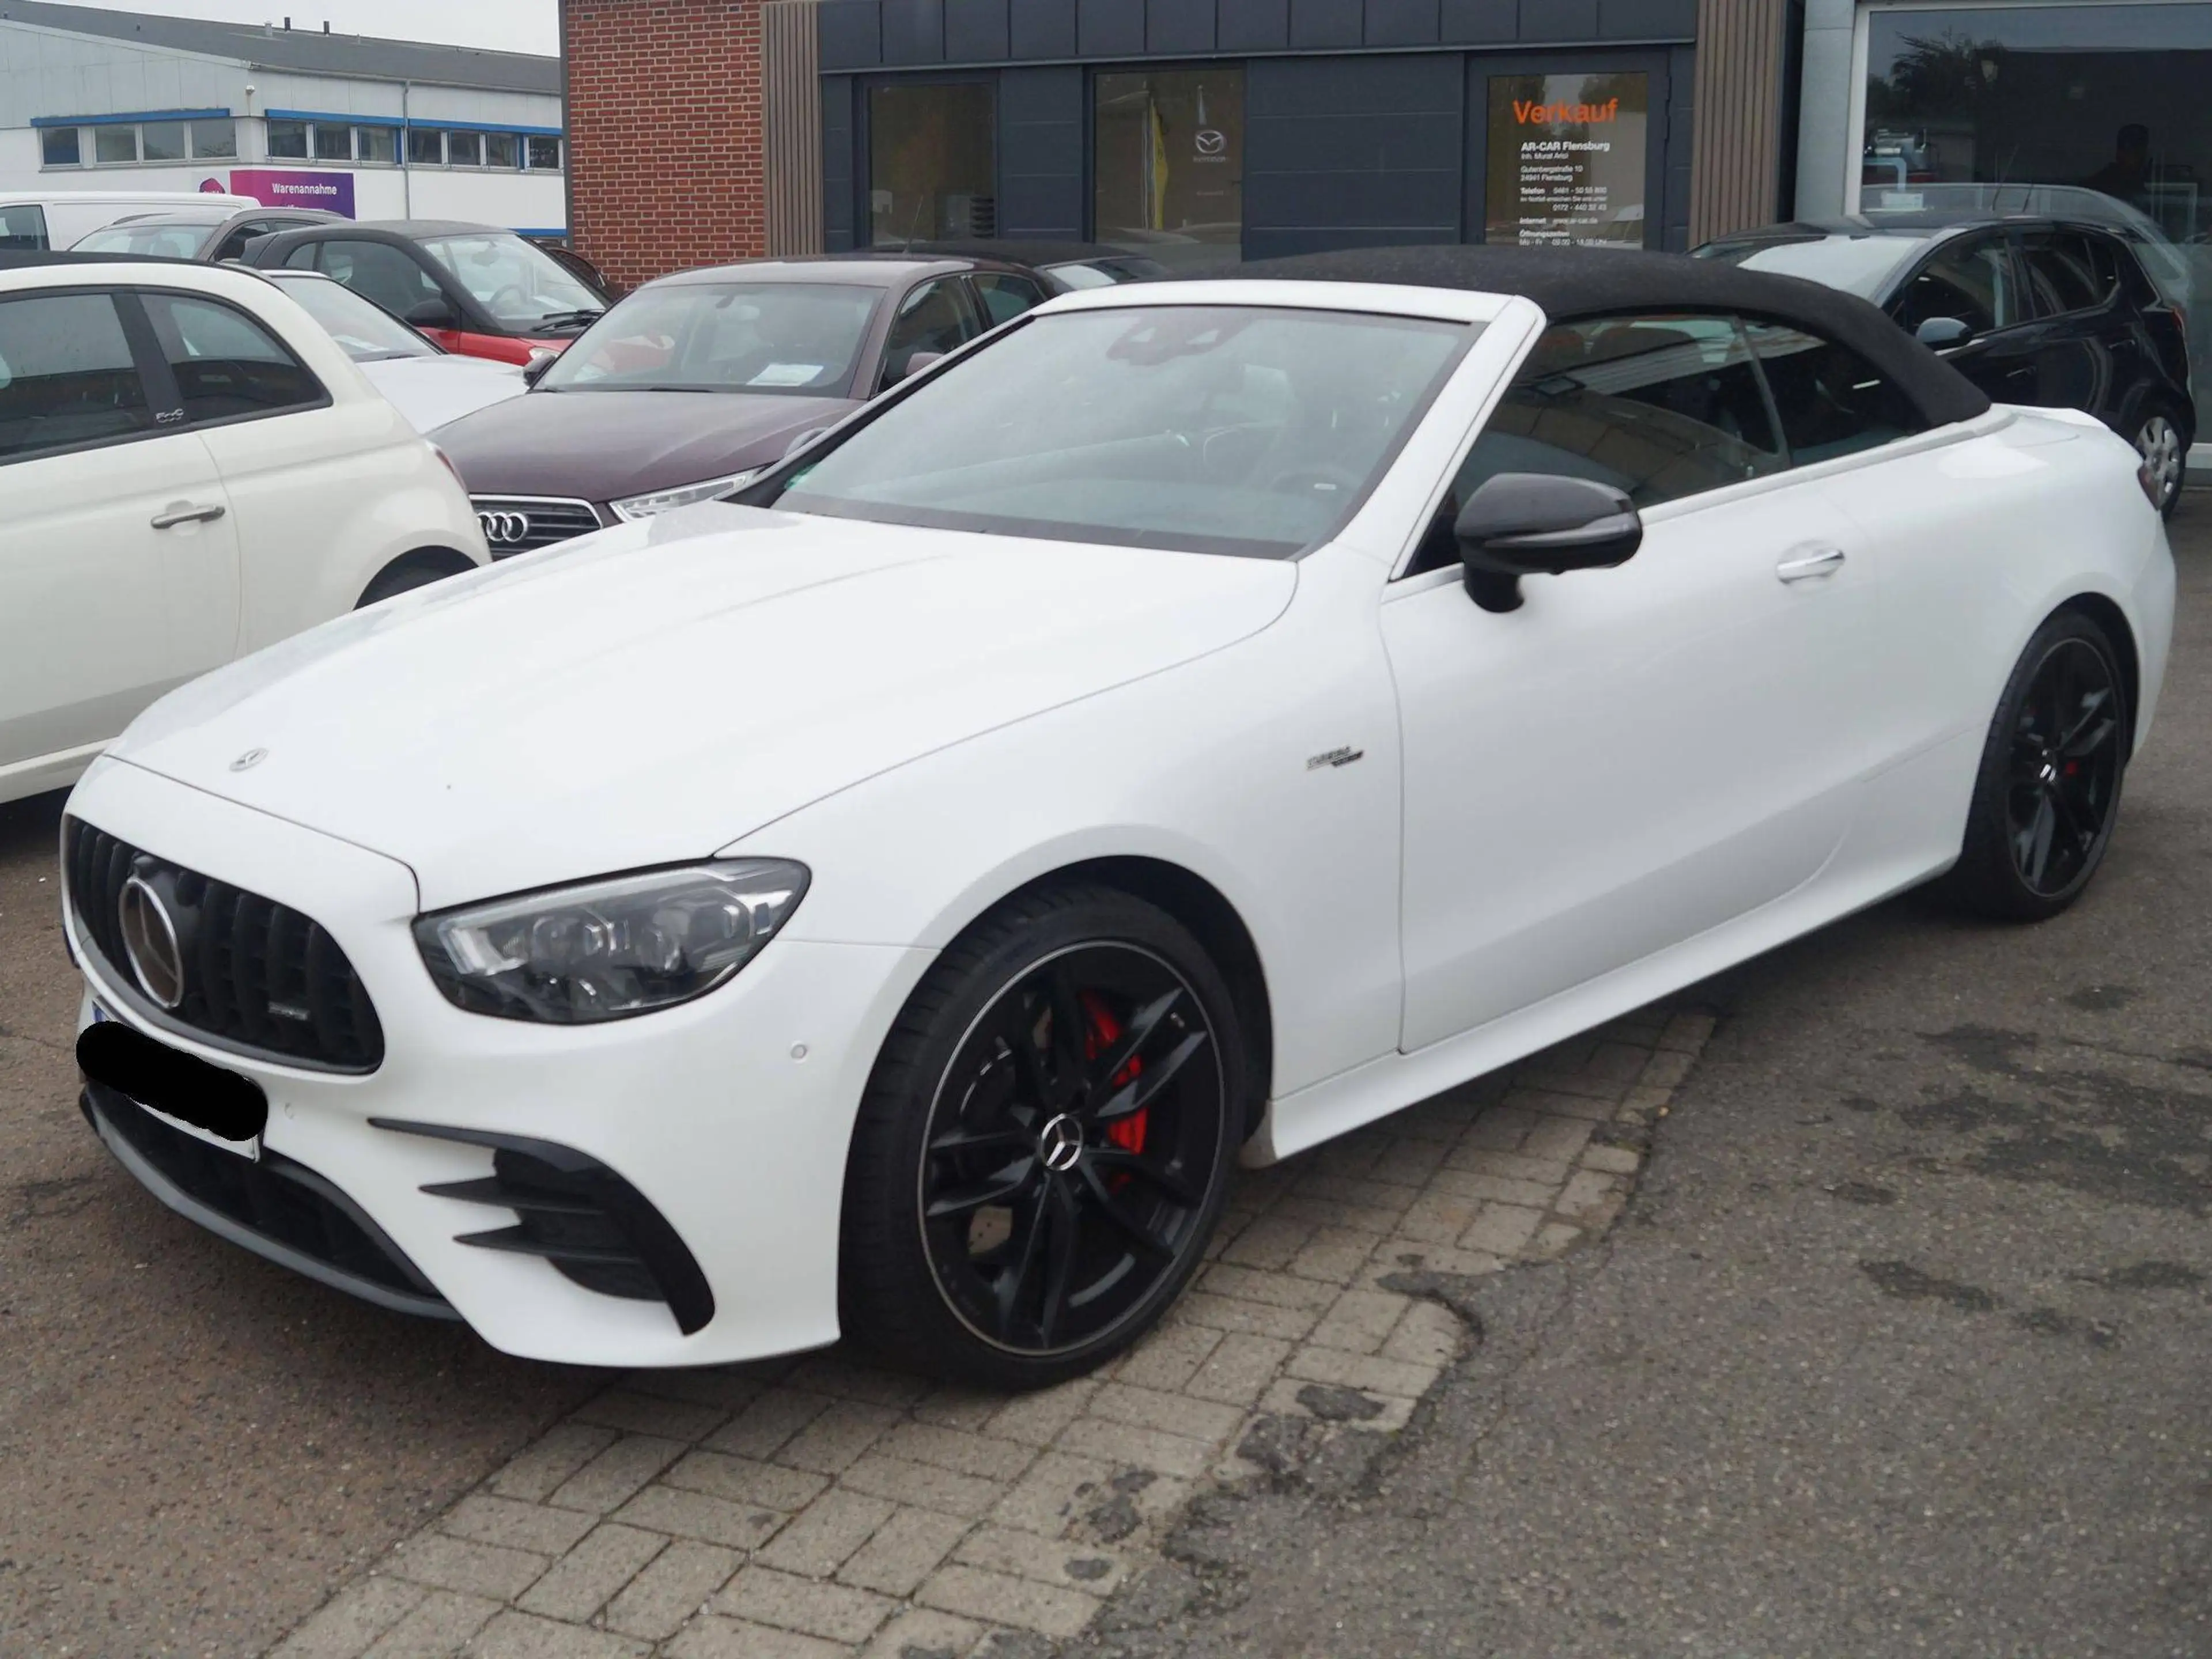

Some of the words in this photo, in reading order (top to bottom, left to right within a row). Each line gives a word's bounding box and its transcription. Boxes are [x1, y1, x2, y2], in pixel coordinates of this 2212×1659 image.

[1513, 97, 1619, 125] Verkauf
[1521, 141, 1560, 151] AR-CAR
[1563, 141, 1610, 152] Flensburg
[272, 183, 337, 195] Warenannahme
